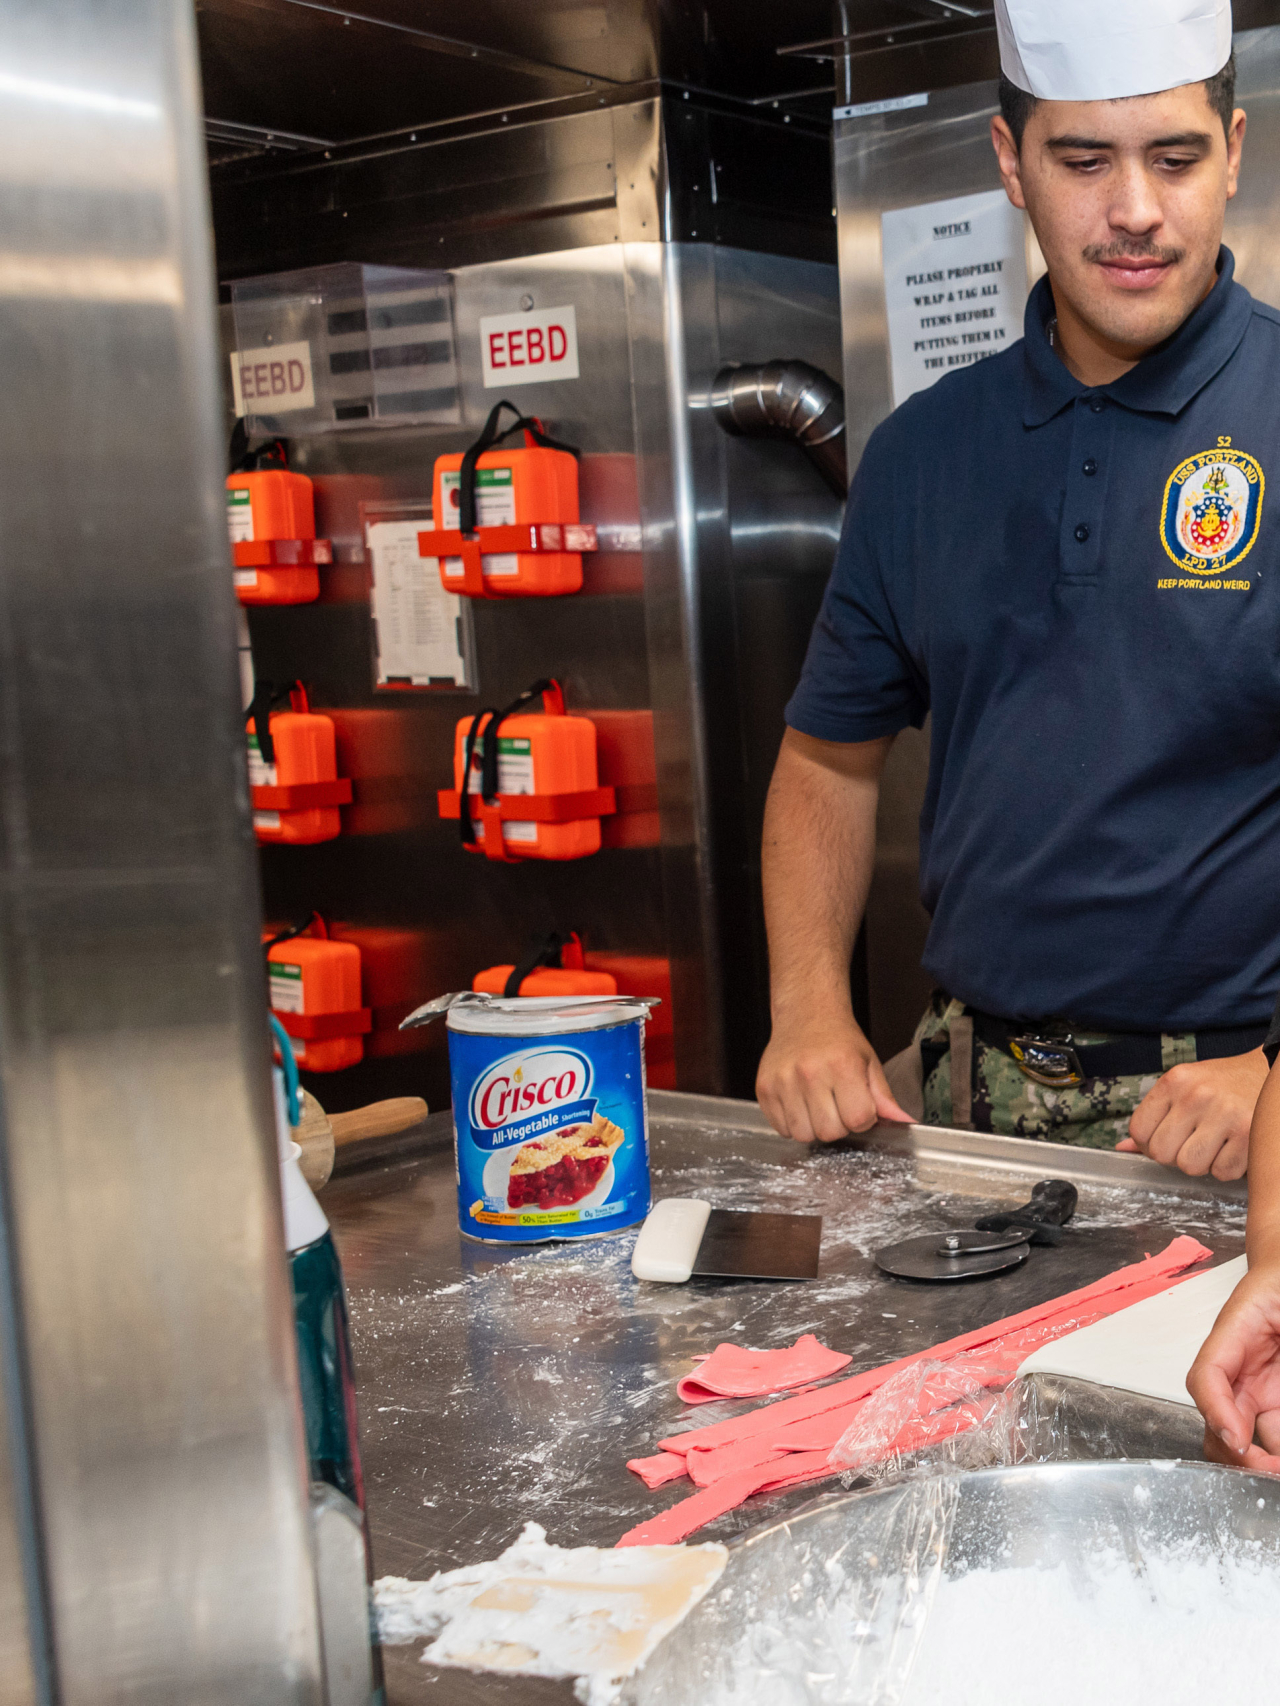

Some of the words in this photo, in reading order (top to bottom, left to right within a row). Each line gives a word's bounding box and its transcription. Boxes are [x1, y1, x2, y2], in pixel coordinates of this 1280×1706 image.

[933, 221, 971, 239] NOTICE
[905, 270, 945, 286] PLEASE
[947, 260, 1004, 280] PROPERLY
[914, 293, 945, 306] WRAP
[947, 290, 954, 302] &
[957, 287, 977, 301] TAG
[981, 284, 999, 297] ALL
[920, 315, 952, 329] ITEMS
[955, 307, 996, 323] BEFORE
[489, 325, 569, 370] EEBD
[914, 336, 959, 351] PUTTING
[962, 331, 991, 344] THEM
[994, 328, 1006, 339] IN
[924, 357, 944, 370] THE
[240, 358, 305, 400] EEBD
[1217, 436, 1232, 448] S2
[1174, 463, 1197, 486] USS
[1198, 453, 1259, 486] PORTLAND
[1182, 553, 1207, 569] LPD
[1212, 554, 1227, 568] 27
[1157, 579, 1178, 589] KEEP
[1178, 579, 1222, 590] PORTLAND
[1223, 580, 1250, 590] WEIRD
[480, 1067, 577, 1129] Crisco
[492, 1113, 559, 1146] All-Vegetable
[561, 1109, 591, 1122] Shortening
